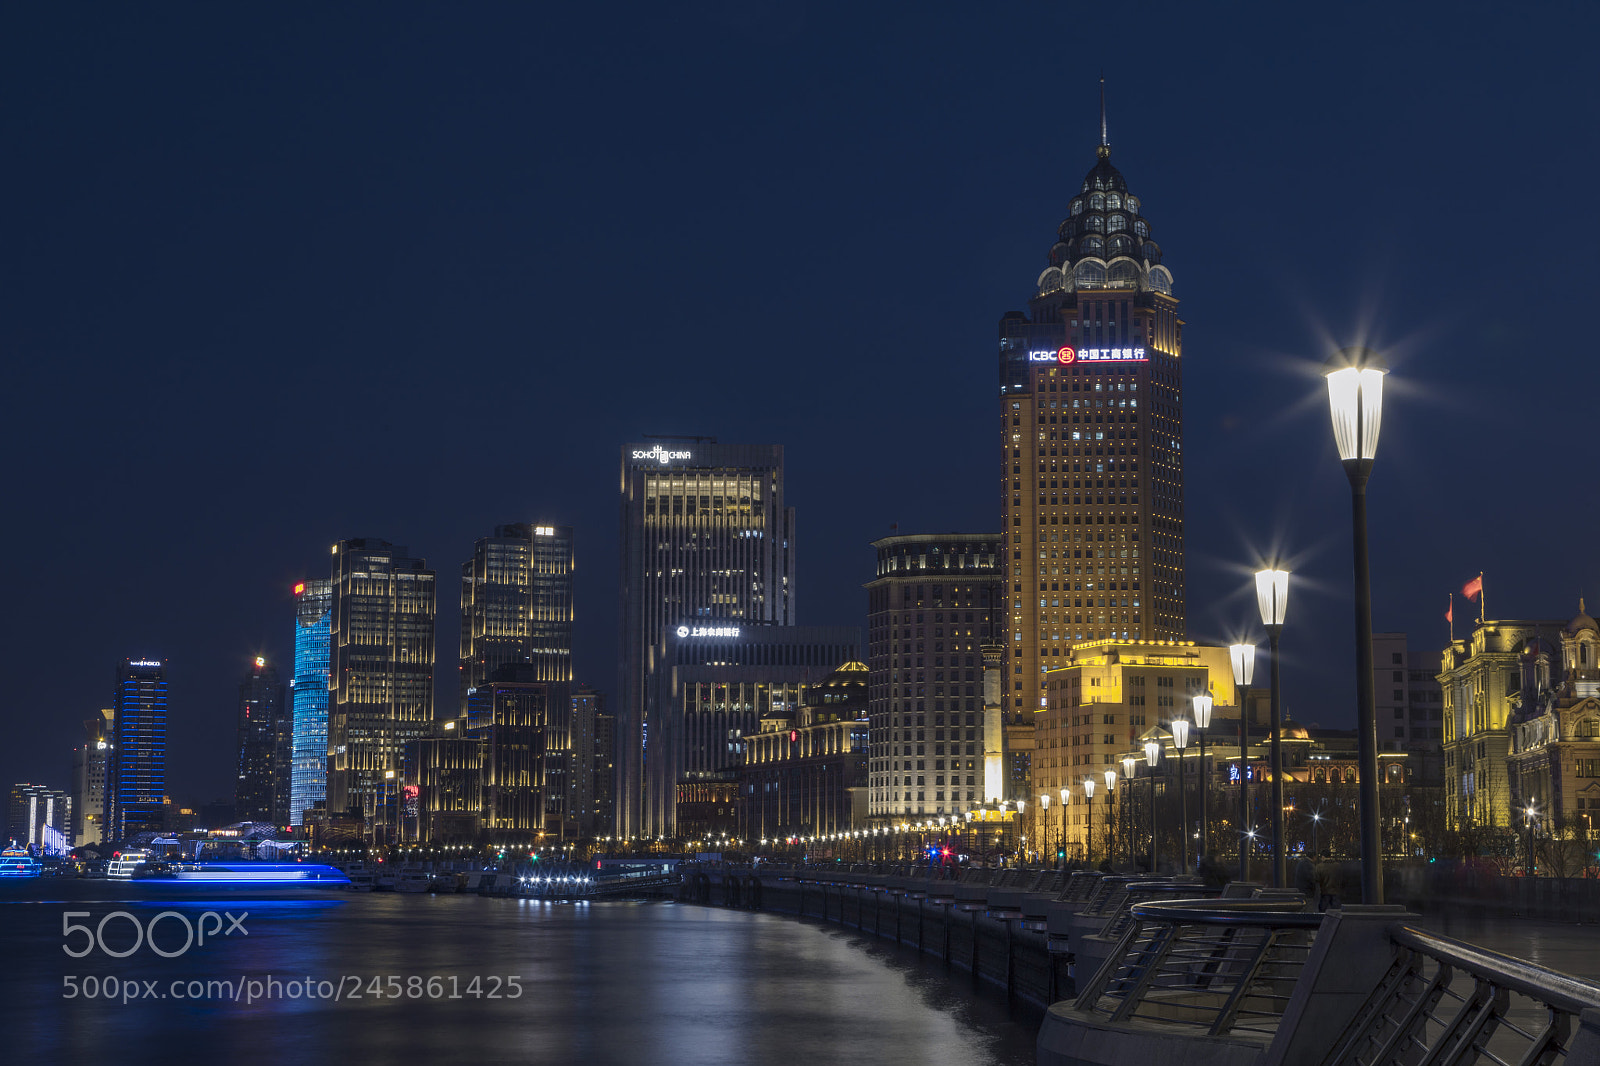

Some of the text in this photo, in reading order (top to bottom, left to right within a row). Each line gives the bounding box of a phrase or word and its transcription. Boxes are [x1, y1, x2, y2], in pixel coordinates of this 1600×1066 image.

[1029, 350, 1058, 361] ICBC
[1078, 348, 1145, 360] 中国工商银行
[632, 450, 656, 459] SOHO
[669, 451, 691, 460] CHINA
